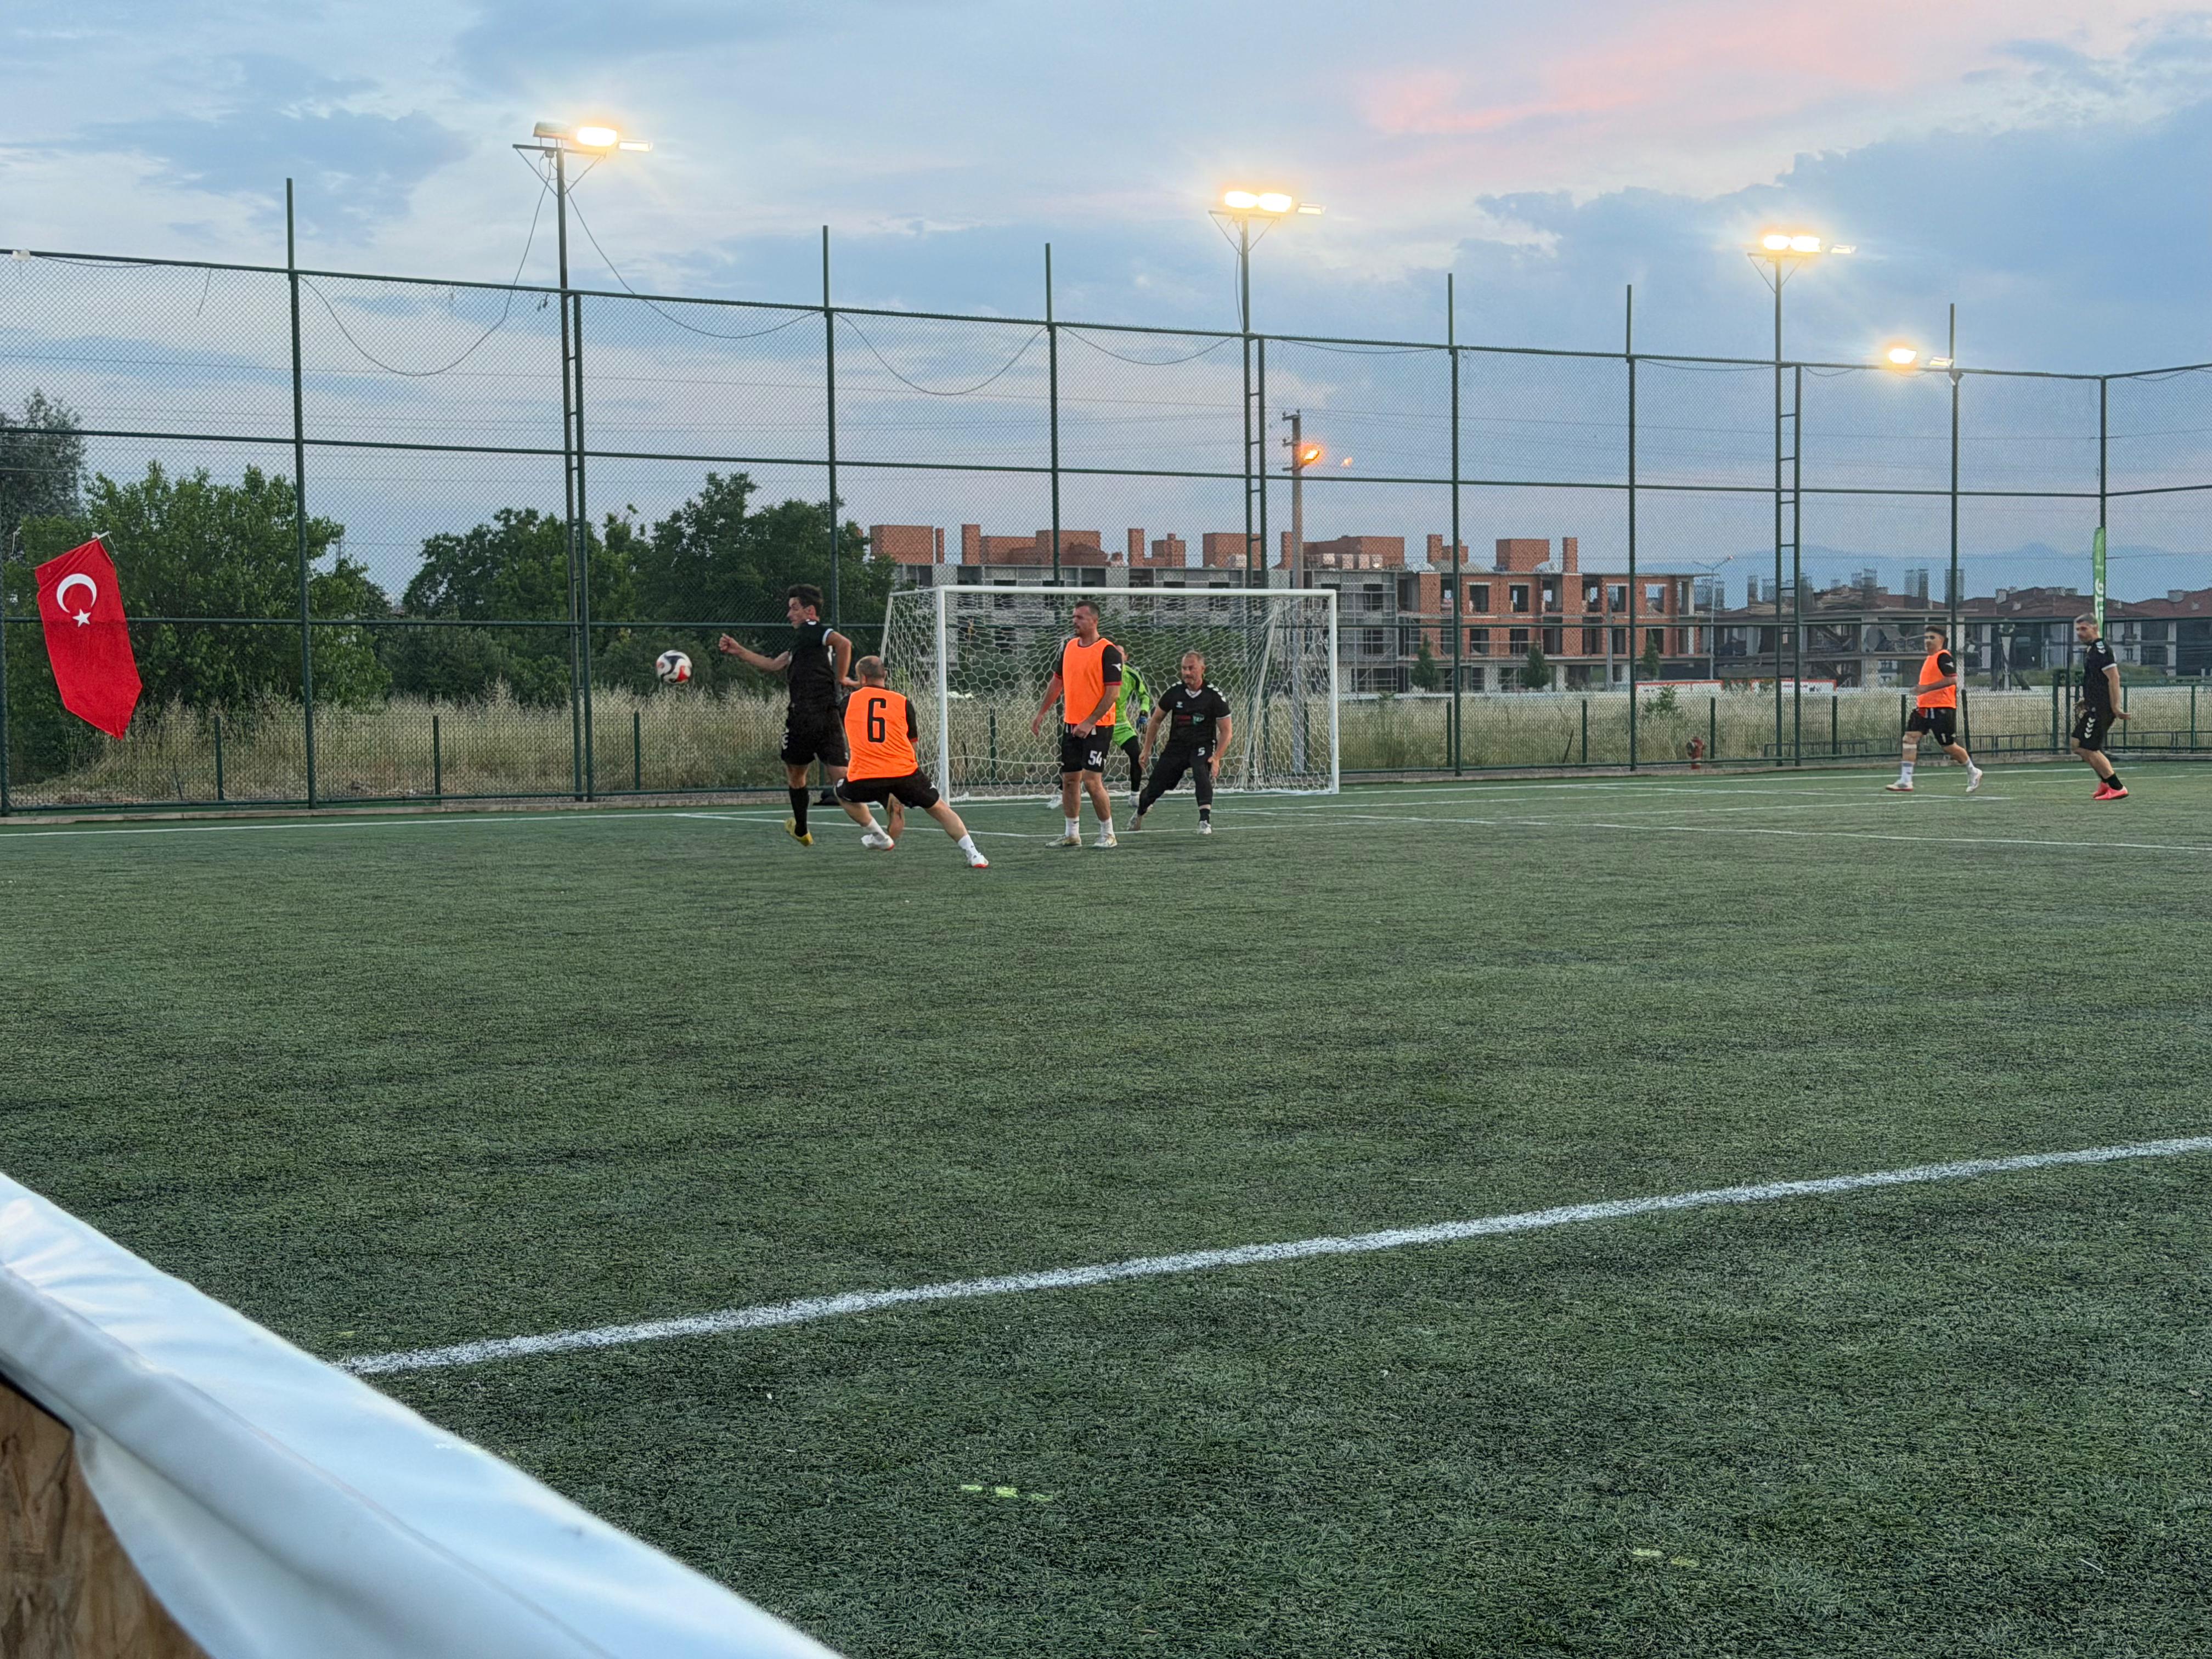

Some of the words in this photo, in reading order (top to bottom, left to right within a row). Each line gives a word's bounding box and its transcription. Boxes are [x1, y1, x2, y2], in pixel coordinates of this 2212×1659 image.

[867, 697, 887, 743] 6
[1088, 750, 1102, 767] 54
[1197, 747, 1206, 757] 5
